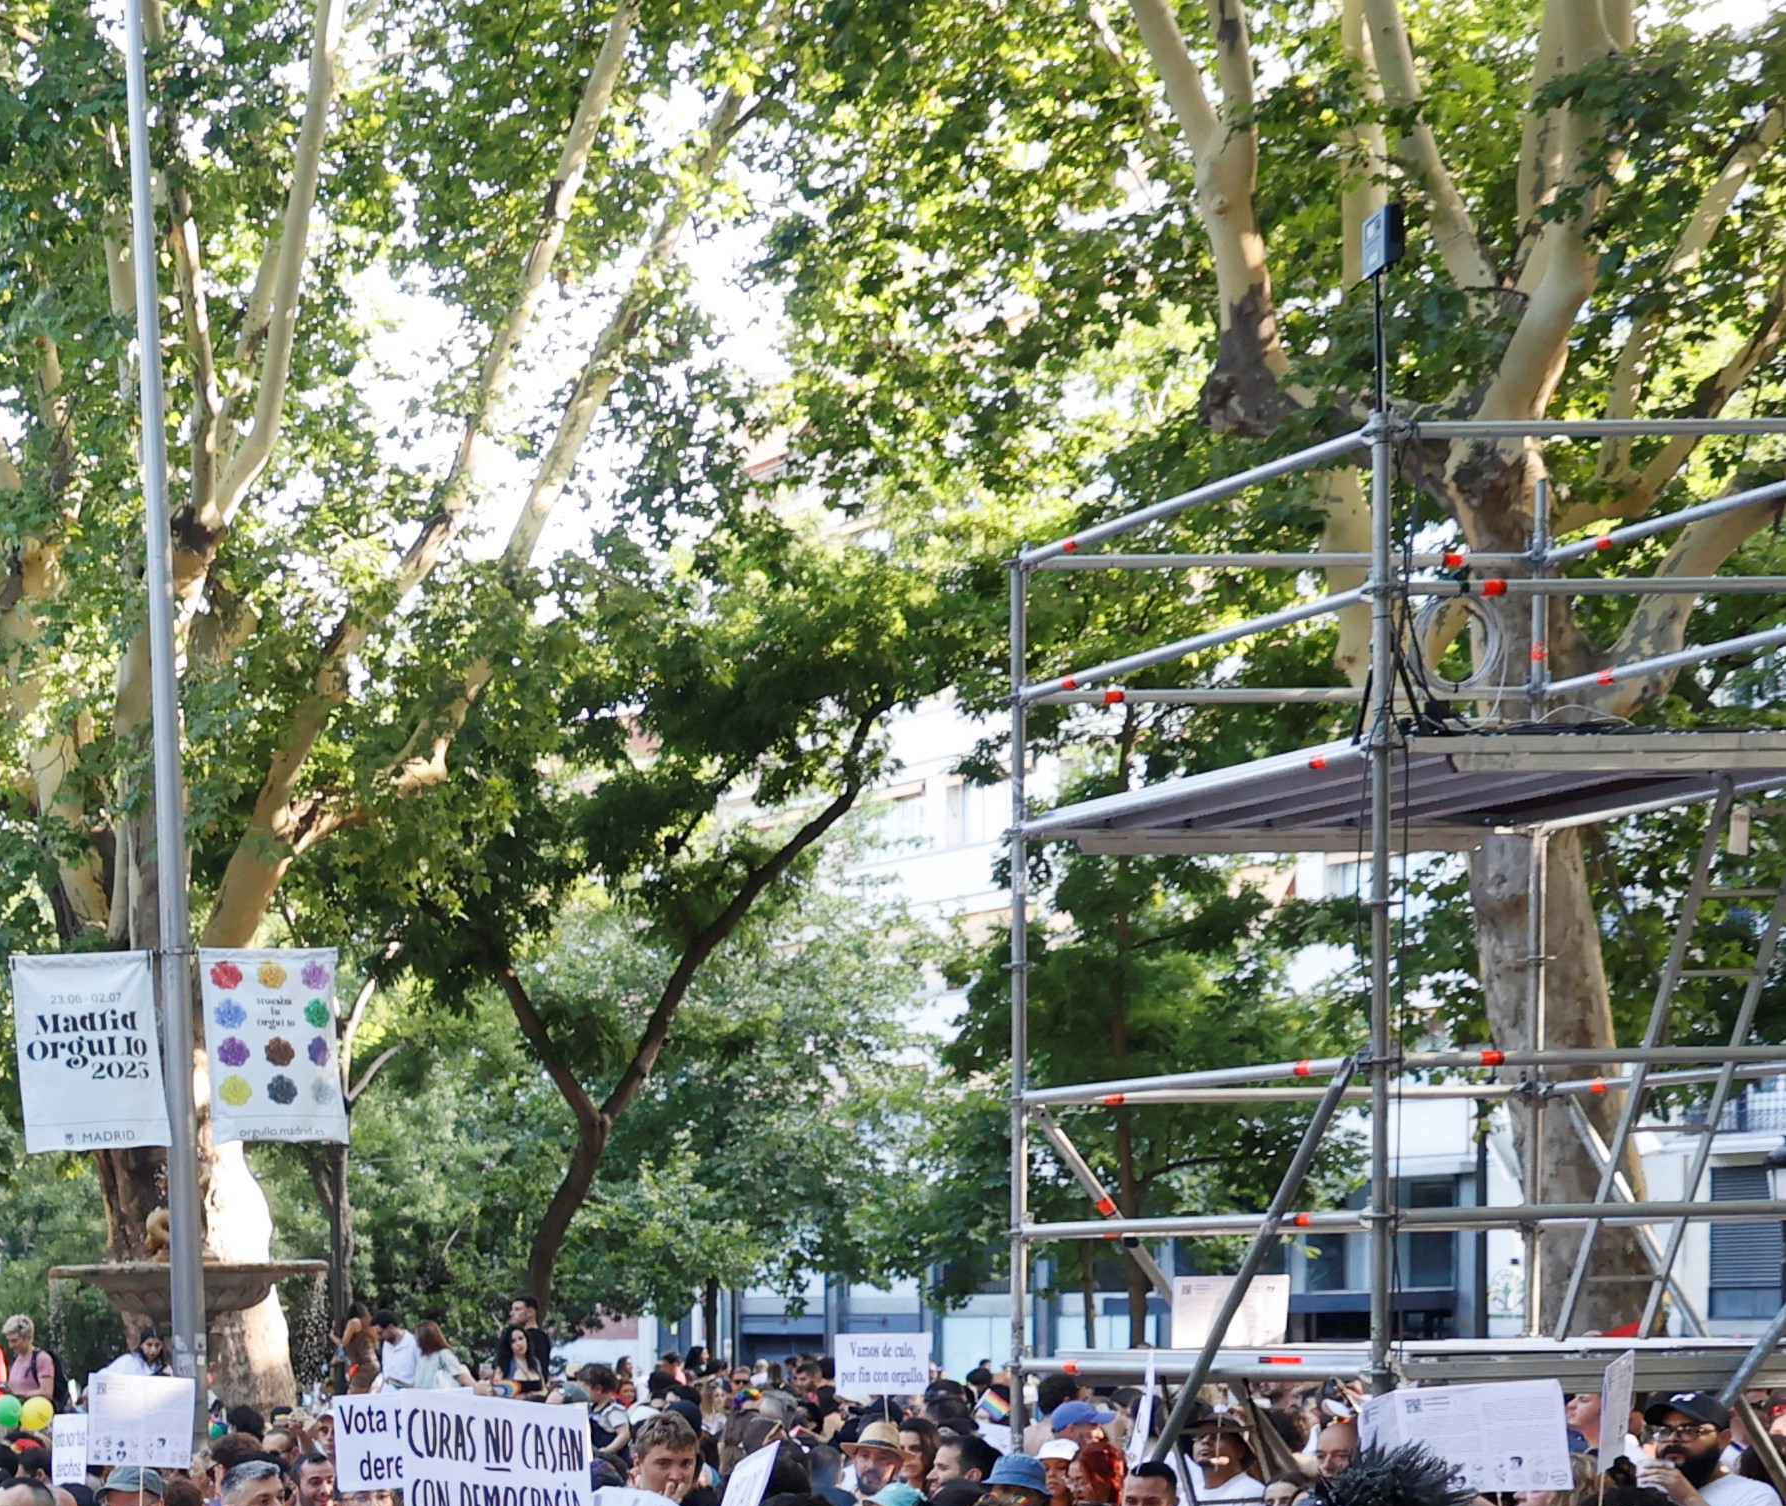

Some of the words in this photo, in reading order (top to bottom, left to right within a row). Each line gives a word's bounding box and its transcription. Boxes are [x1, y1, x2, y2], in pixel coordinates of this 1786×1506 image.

[90, 992, 122, 1004] 02.07
[35, 1008, 137, 1036] Madrid
[91, 1061, 150, 1081] 2023
[82, 1130, 135, 1144] MADRID
[850, 1341, 879, 1358] Vamos
[882, 1341, 892, 1358] de
[841, 1371, 856, 1388] por
[859, 1366, 870, 1383] fin
[873, 1370, 890, 1383] con
[339, 1404, 387, 1436] Vota
[407, 1407, 477, 1464] CURAS
[484, 1417, 514, 1465] NO
[521, 1421, 584, 1474] CASAN
